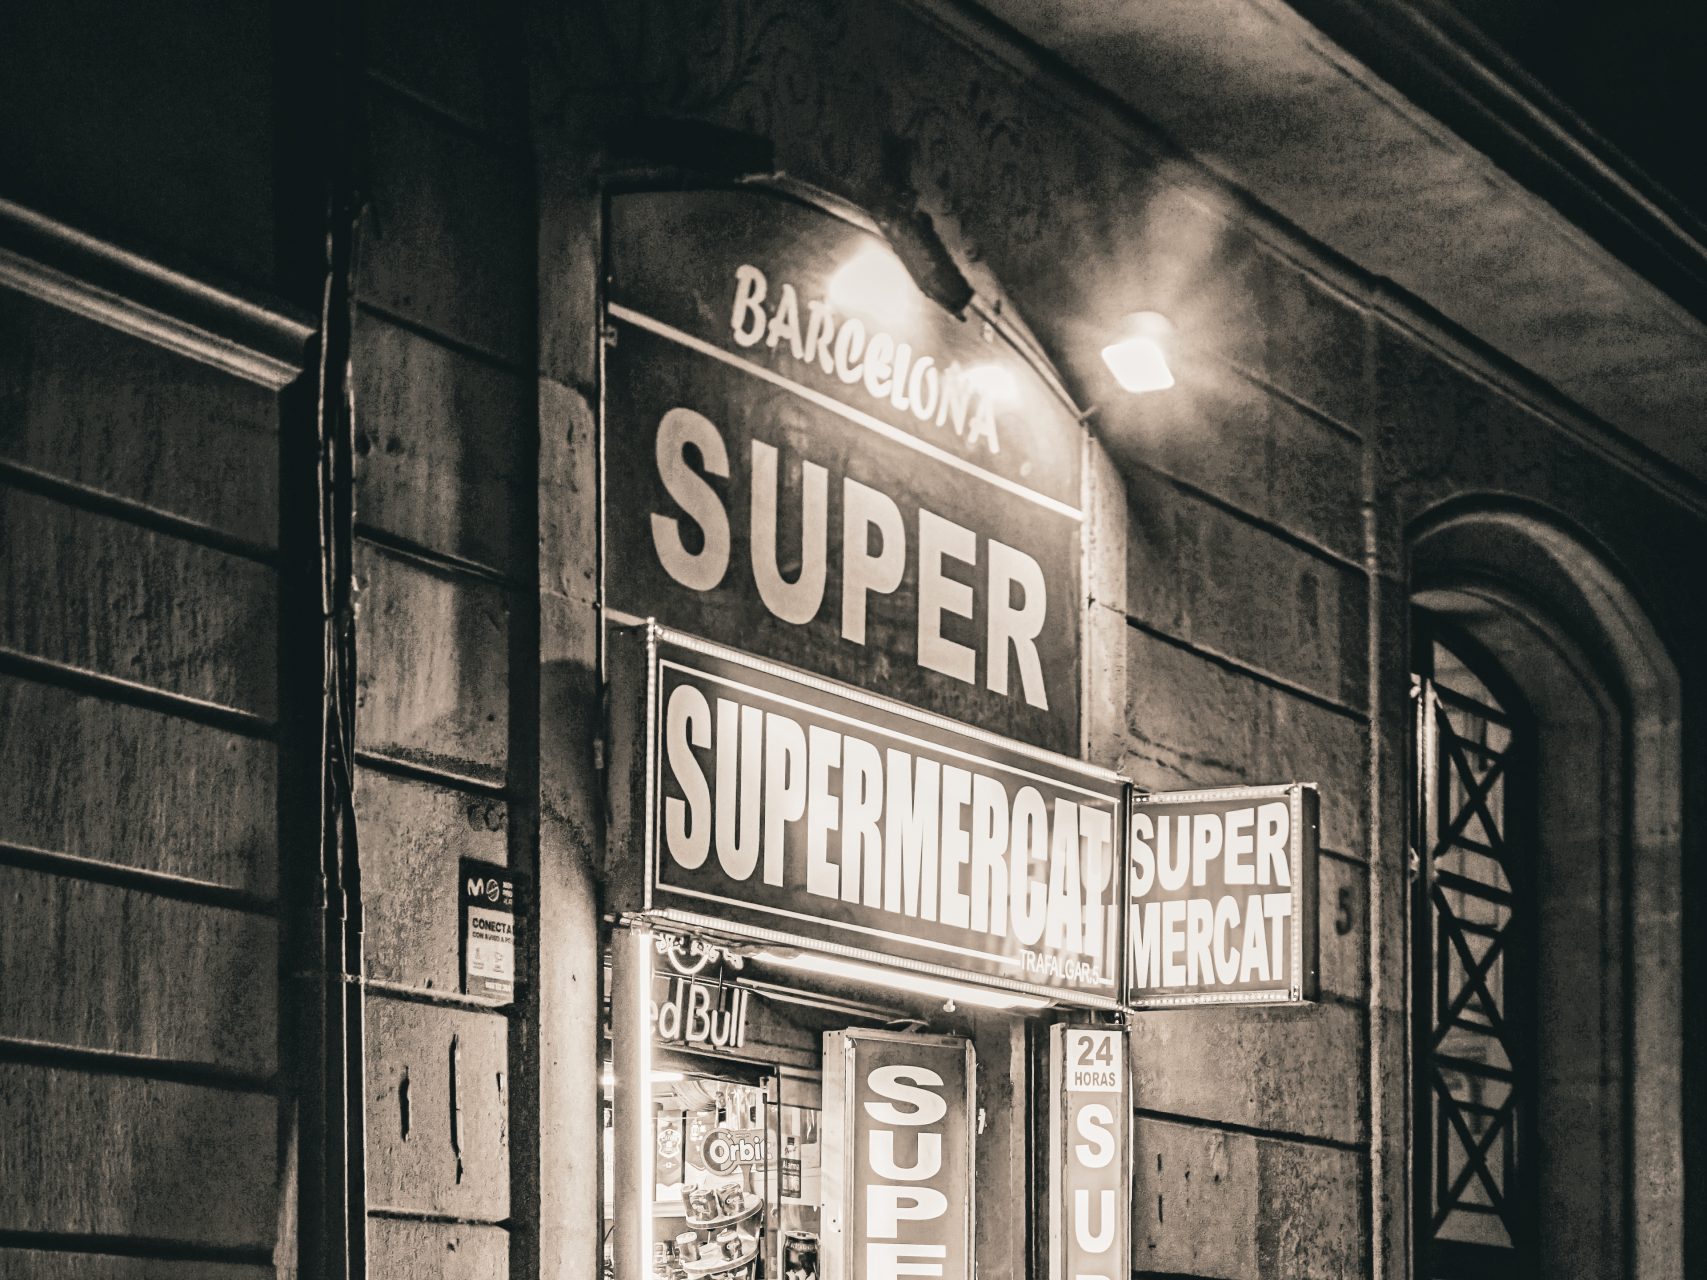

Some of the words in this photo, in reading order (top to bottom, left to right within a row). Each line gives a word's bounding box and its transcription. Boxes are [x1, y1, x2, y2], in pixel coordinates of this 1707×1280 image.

[731, 264, 1000, 454] BARCELONA
[650, 407, 1049, 711] SUPER
[665, 684, 1112, 957] SUPERMERCAT
[1131, 802, 1291, 898] SUPER
[1129, 892, 1292, 989] MERCAT
[685, 983, 748, 1048] Bull
[1077, 1036, 1113, 1066] 24
[1074, 1071, 1116, 1087] HORAS
